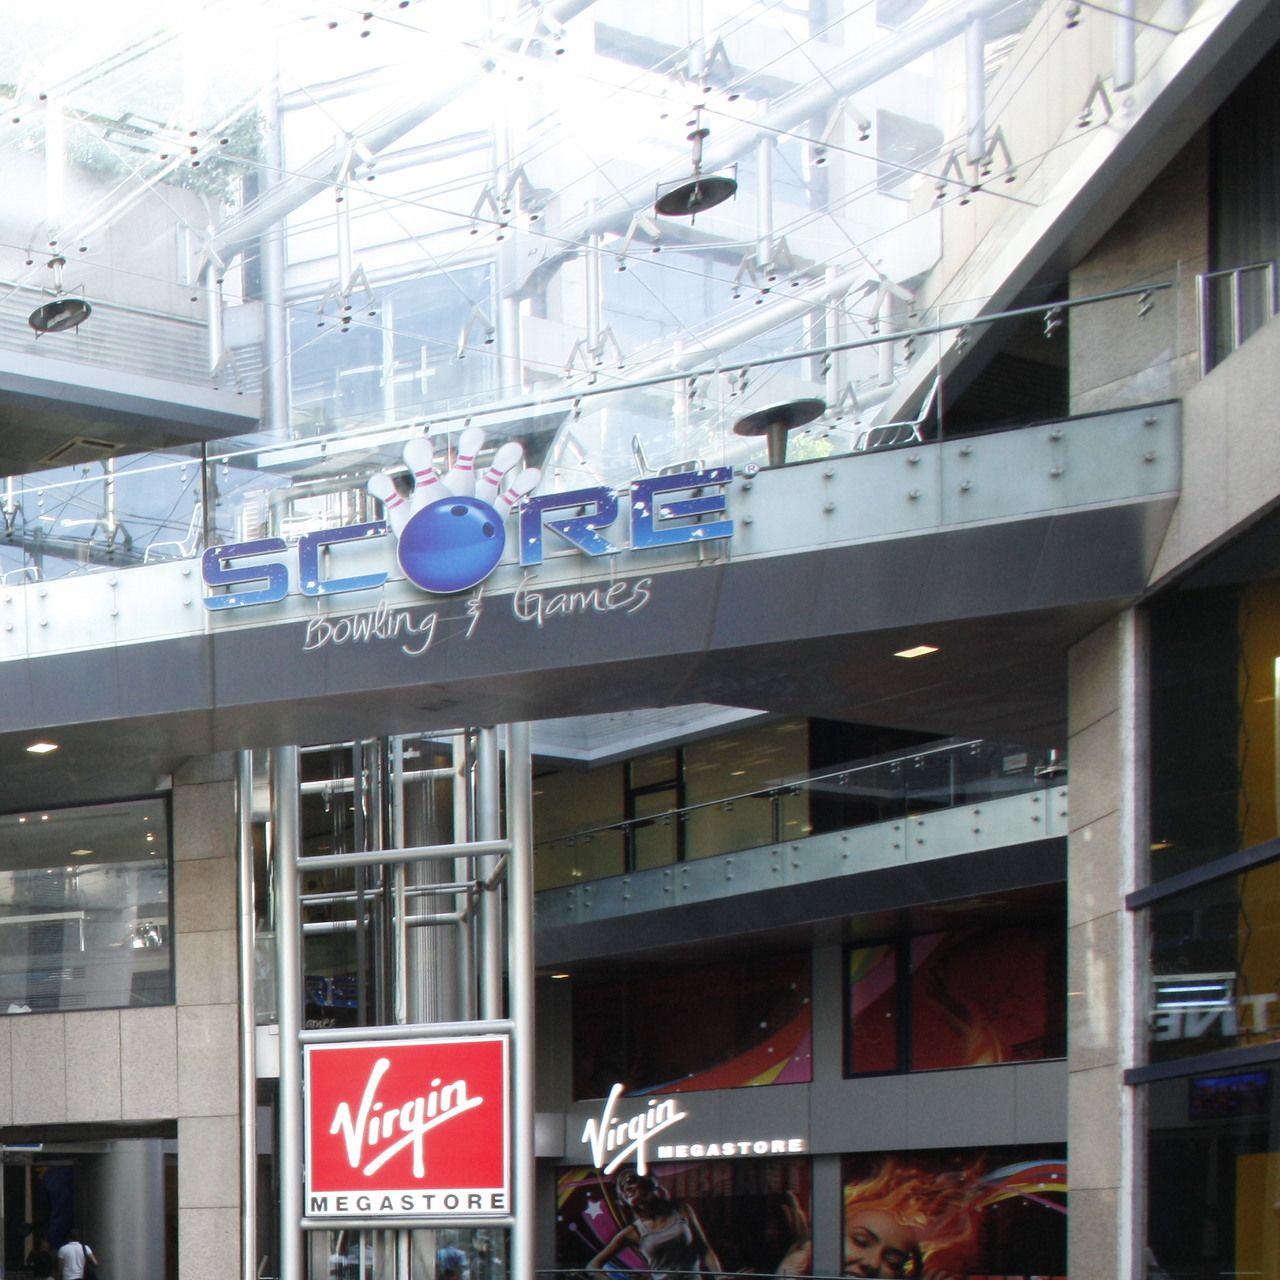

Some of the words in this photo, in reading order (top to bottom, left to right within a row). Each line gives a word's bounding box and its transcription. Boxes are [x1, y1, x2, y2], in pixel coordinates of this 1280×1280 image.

[202, 465, 734, 611] SCORE
[303, 602, 440, 656] Bowling
[514, 573, 653, 626] Games
[329, 1057, 484, 1178] Virgin
[581, 1082, 688, 1176] Virgin
[657, 1137, 805, 1159] MEGASTORE
[310, 1191, 507, 1214] MEGASTORE
